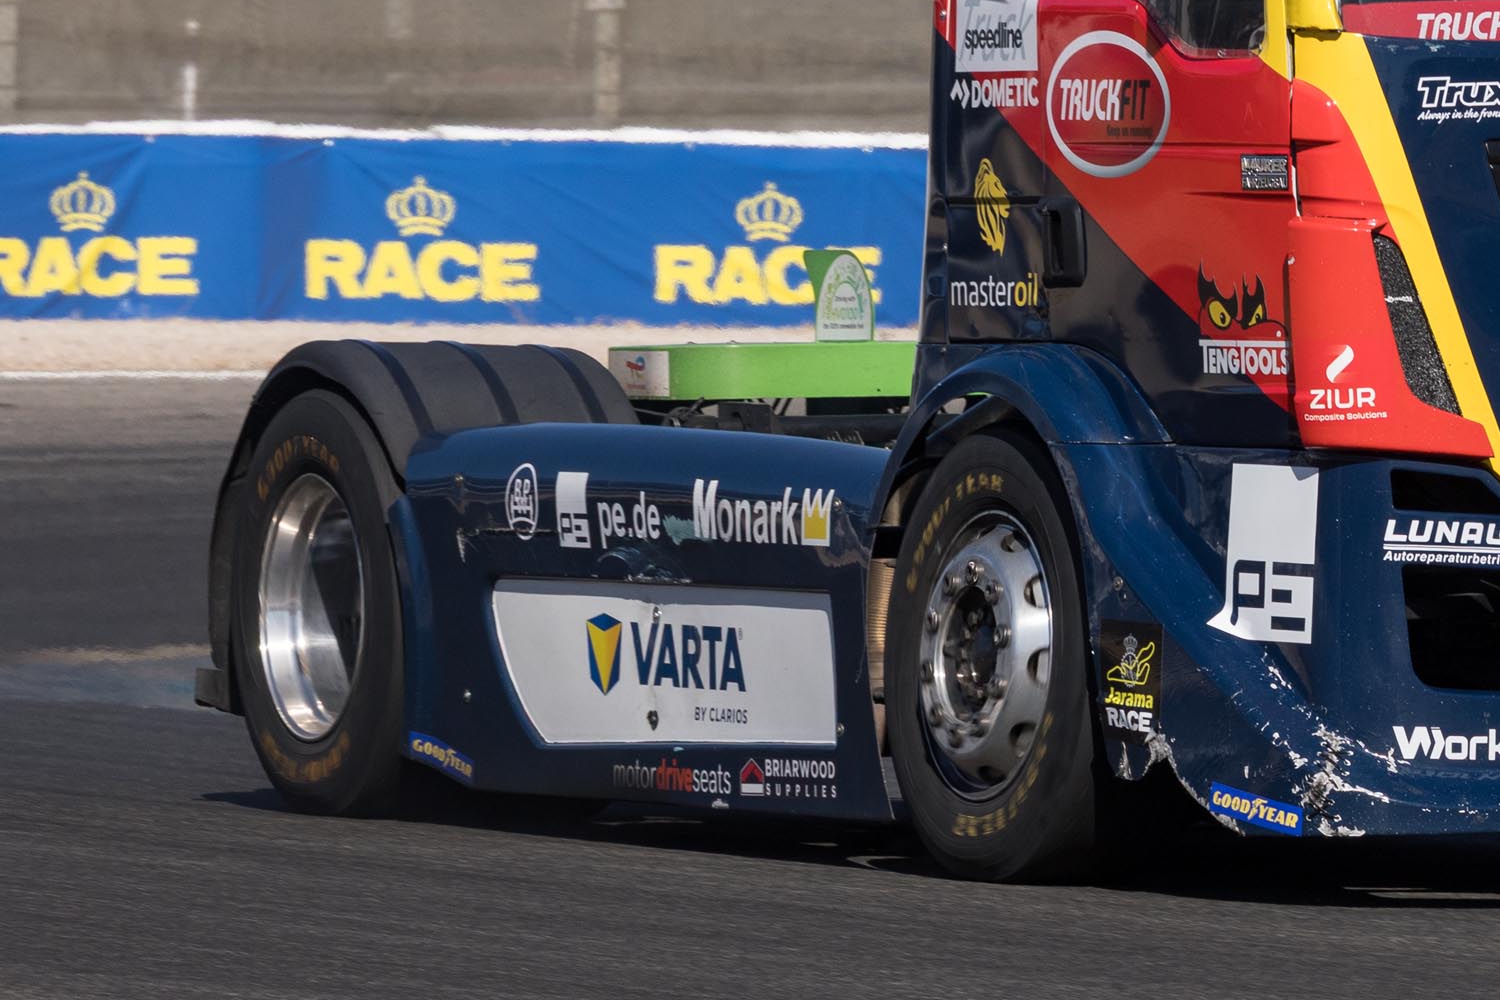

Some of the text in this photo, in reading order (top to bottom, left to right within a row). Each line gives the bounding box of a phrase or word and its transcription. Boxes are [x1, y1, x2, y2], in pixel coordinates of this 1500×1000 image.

[964, 22, 1023, 55] speedline
[971, 78, 1039, 108] DOMETIC
[1060, 78, 1151, 121] TRUCKFIT
[1416, 109, 1450, 124] Always
[1451, 109, 1463, 119] in
[1464, 108, 1479, 119] the
[305, 239, 540, 302] RACE
[951, 272, 1038, 307] masteroil
[1309, 387, 1376, 409] ZIUR
[1304, 410, 1388, 423] Composite Solutions
[597, 491, 661, 549] pe.de
[693, 478, 799, 545] Monark
[1230, 559, 1314, 632] PE
[630, 621, 747, 692] VARTA
[1104, 687, 1153, 709] Jarama
[694, 706, 748, 724] BY CLARIOS
[1105, 707, 1153, 733] RACE
[612, 758, 732, 795] motordriveseats
[765, 759, 836, 779] BRIARWOOD
[765, 783, 838, 799] SUPPLIES
[1212, 789, 1299, 829] GOODYEAR
